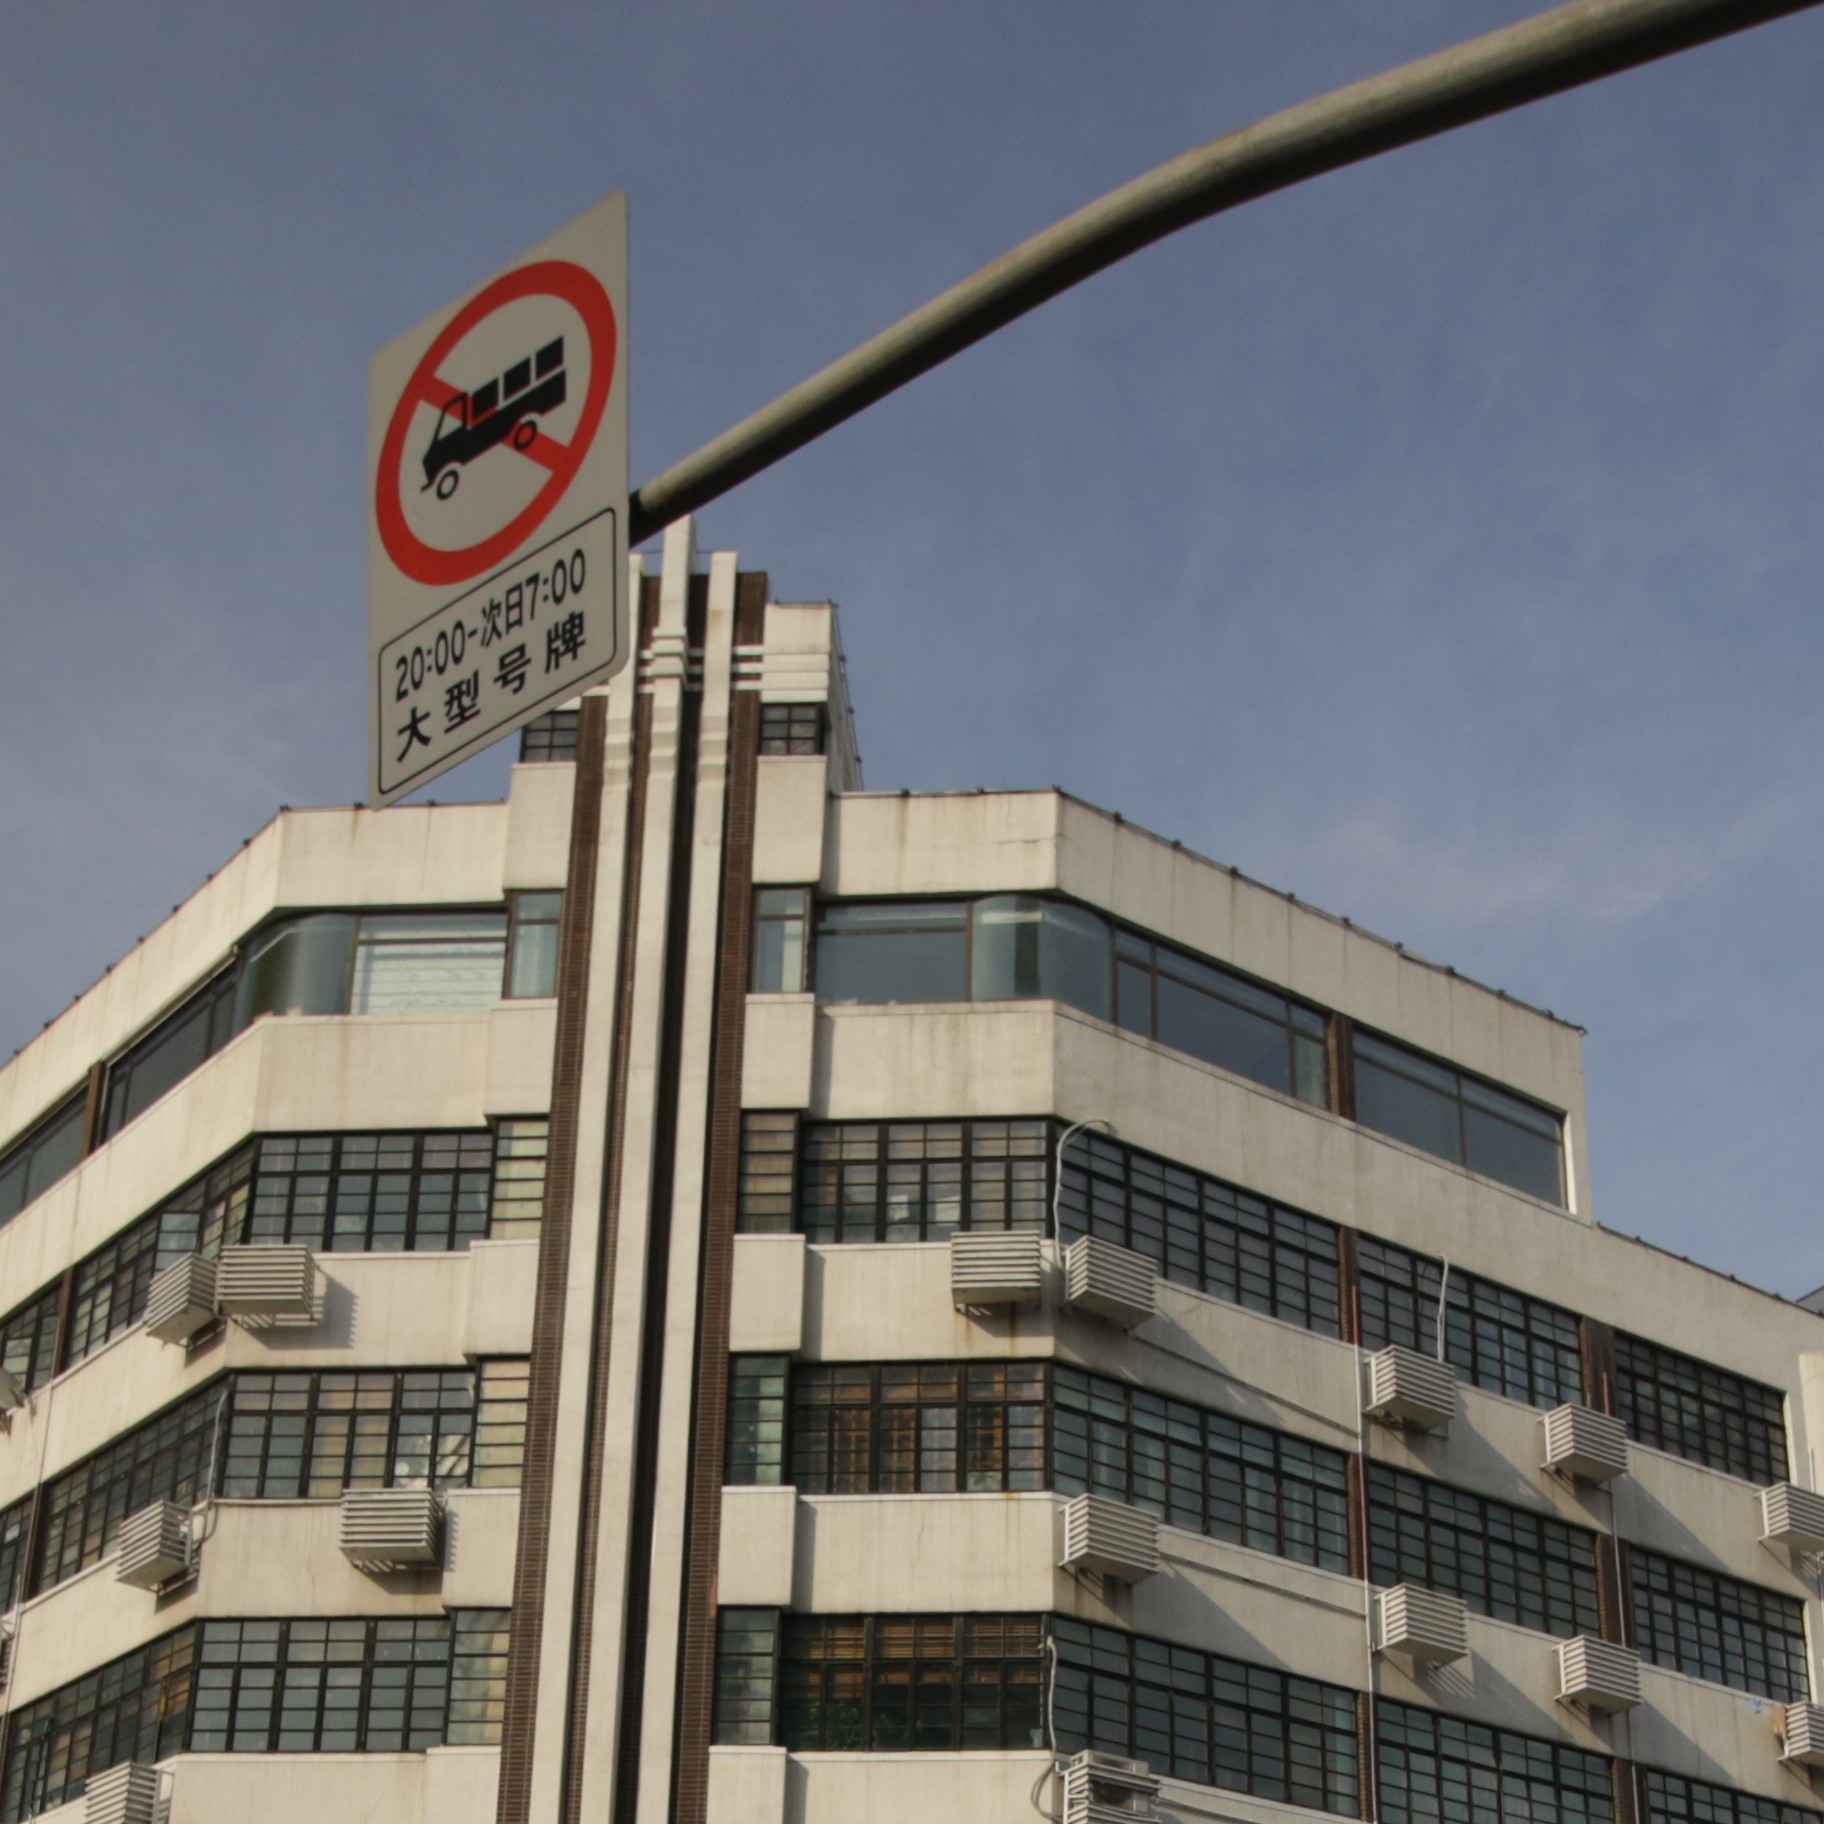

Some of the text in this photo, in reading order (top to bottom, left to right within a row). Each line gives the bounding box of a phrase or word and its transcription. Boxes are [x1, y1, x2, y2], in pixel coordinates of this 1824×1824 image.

[395, 548, 586, 702] 20:00-次日7:00
[396, 611, 587, 763] 大型号牌
